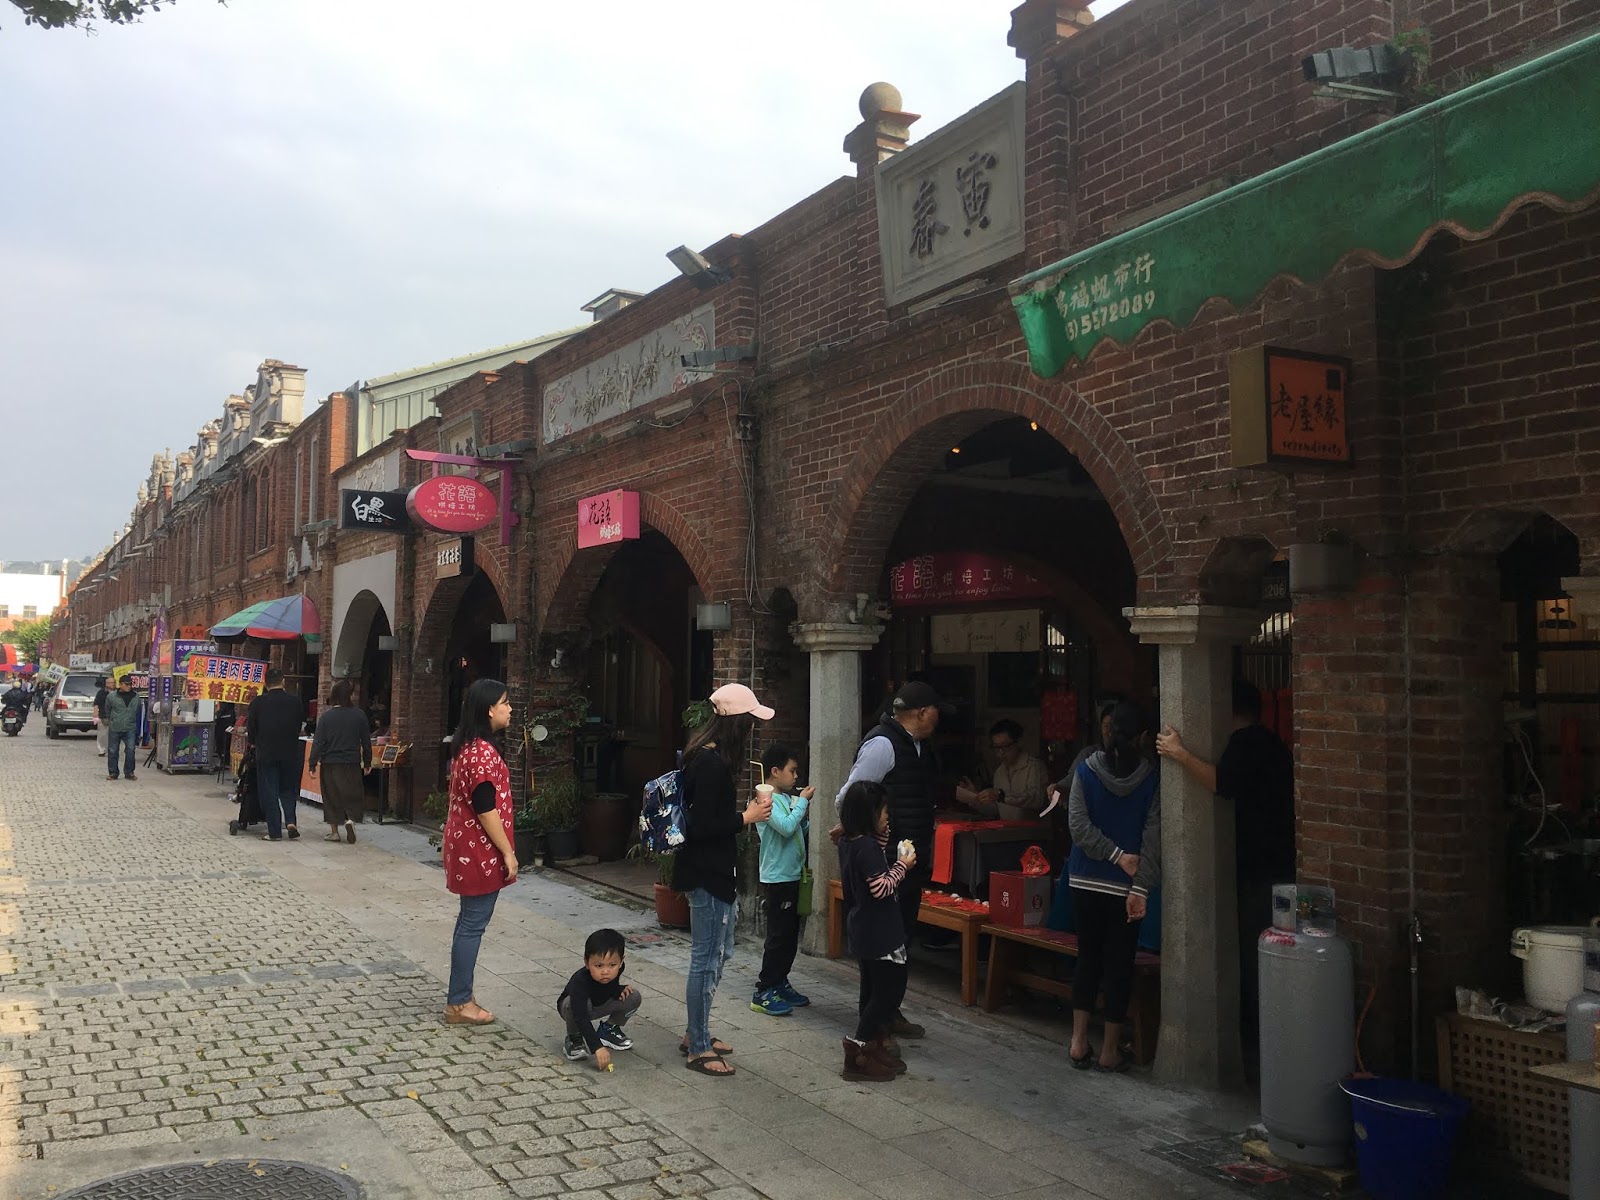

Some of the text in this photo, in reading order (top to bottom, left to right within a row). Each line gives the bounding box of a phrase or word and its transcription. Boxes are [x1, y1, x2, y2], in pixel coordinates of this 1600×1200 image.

[1271, 383, 1340, 434] 老屋緣
[438, 483, 476, 503] 花語
[966, 587, 989, 597] enjoy
[207, 658, 263, 683] 黑豬肉香腸
